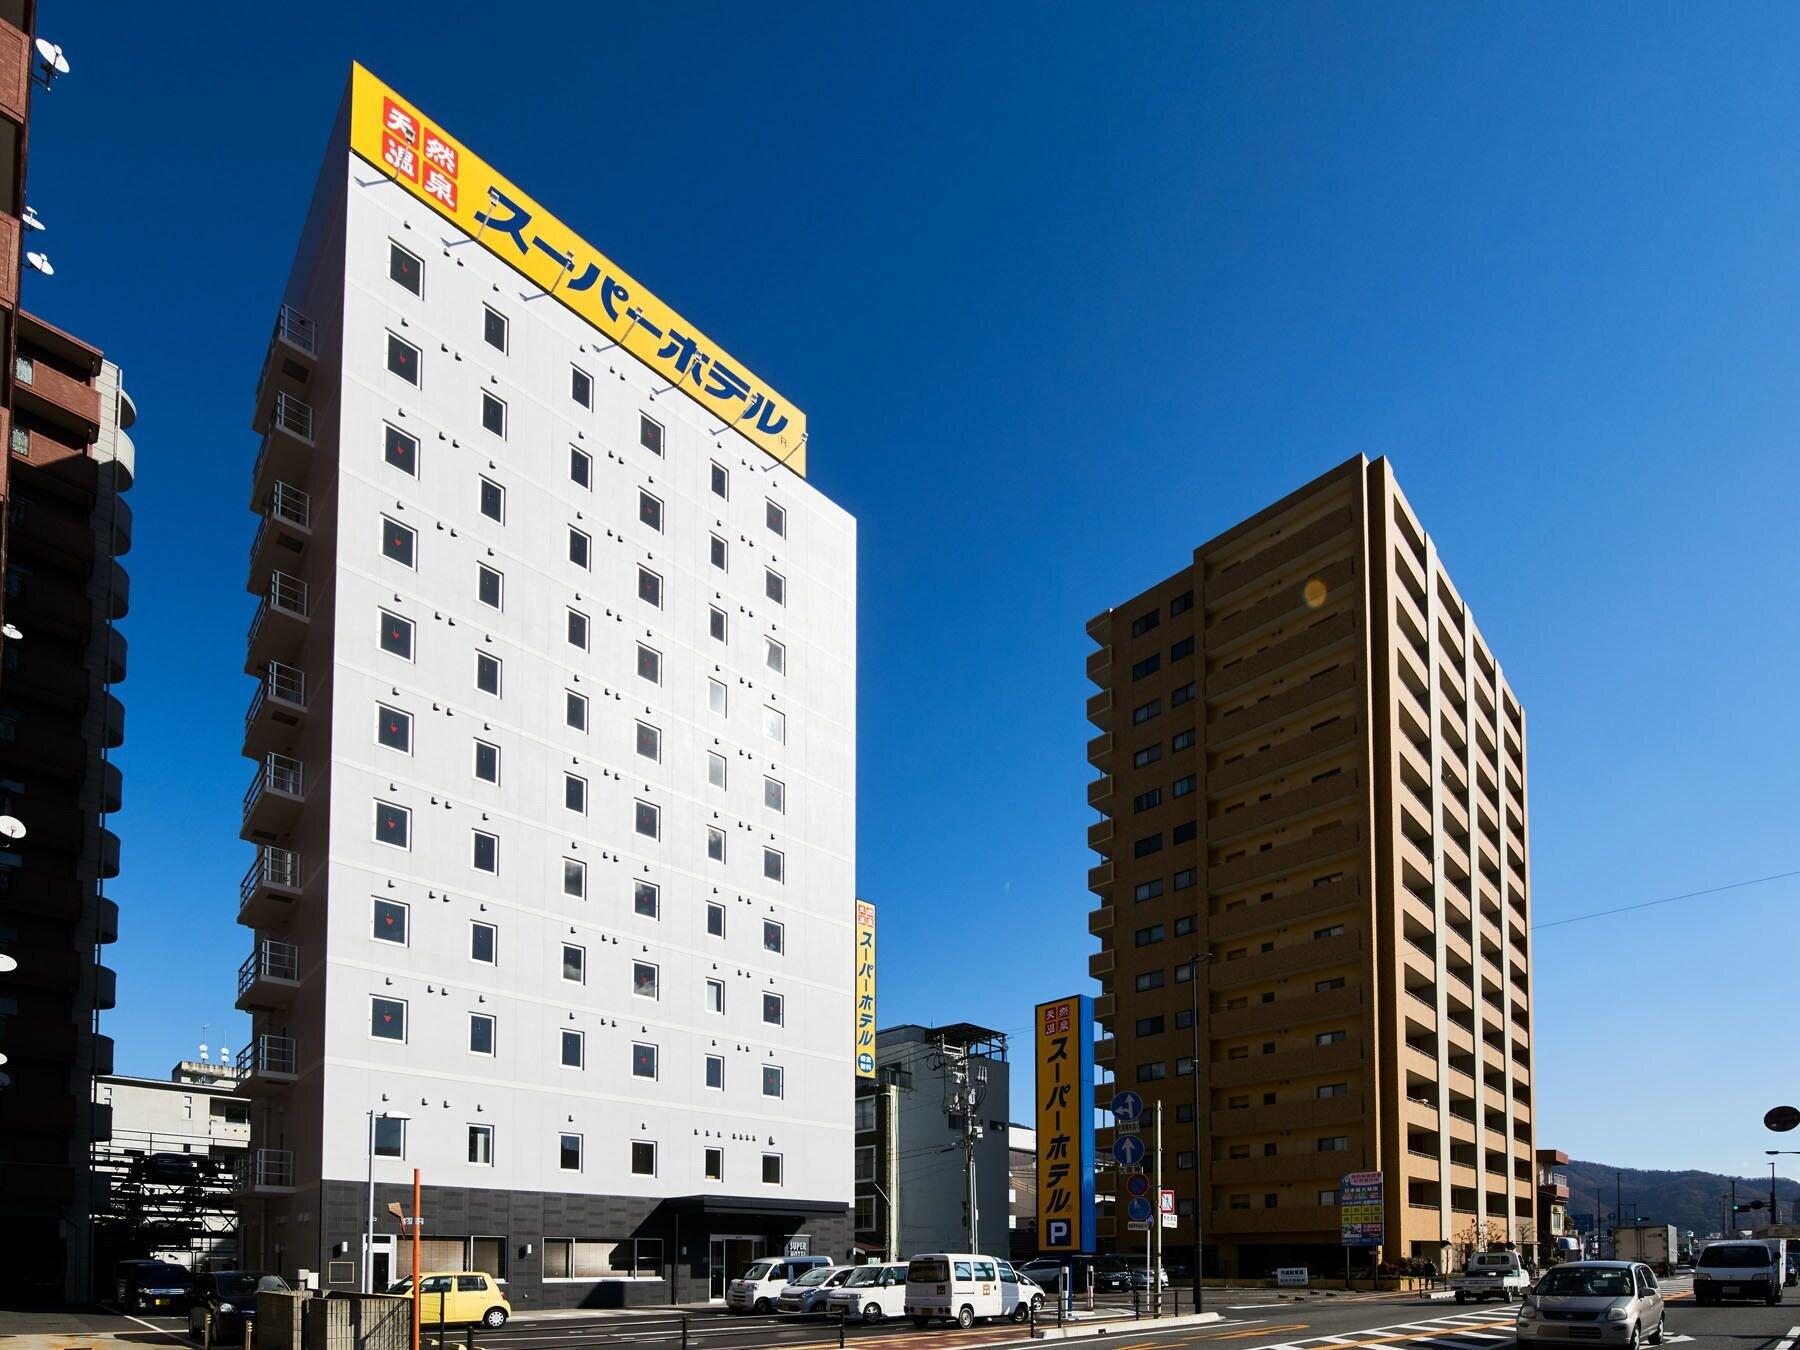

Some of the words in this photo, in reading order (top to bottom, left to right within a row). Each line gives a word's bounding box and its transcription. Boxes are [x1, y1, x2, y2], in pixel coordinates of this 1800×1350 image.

[384, 138, 456, 208] 温泉
[387, 107, 456, 174] 天然
[474, 186, 788, 438] スーパーホテル
[858, 931, 874, 1046] スーパーホテル
[1045, 1036, 1072, 1214] スーパーホテル
[790, 1241, 807, 1250] SUPER
[1050, 1222, 1068, 1244] P
